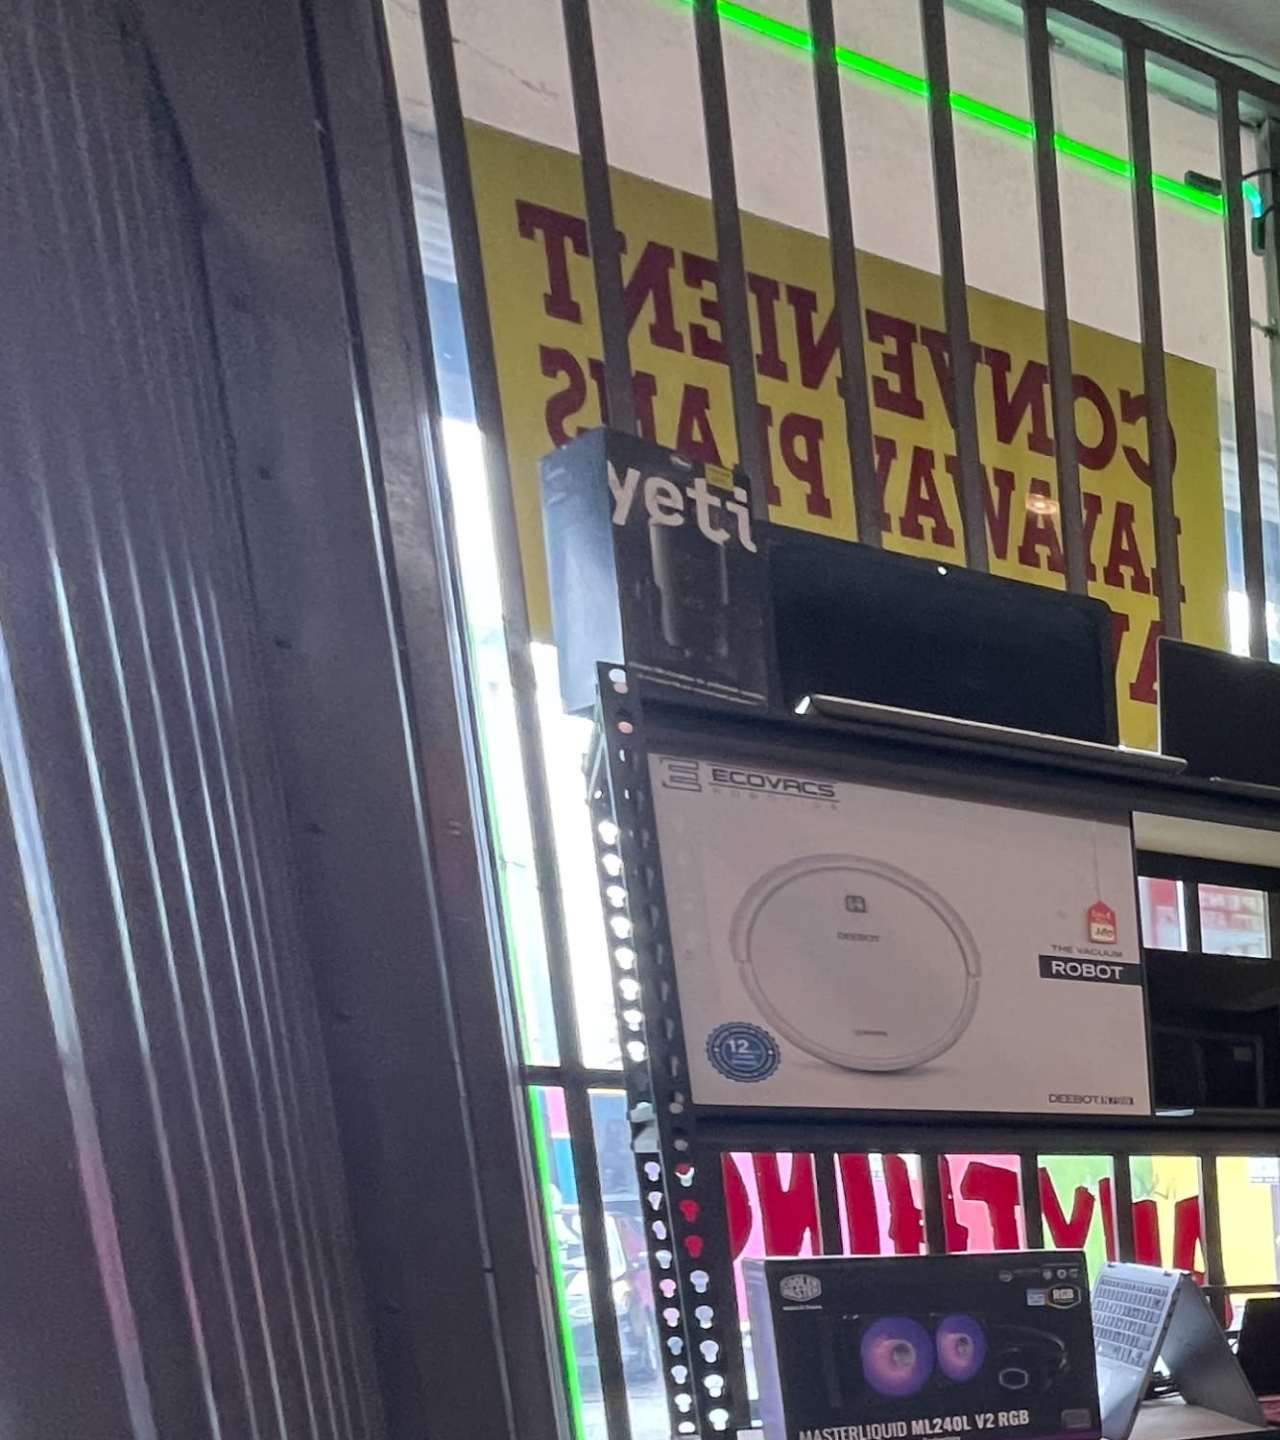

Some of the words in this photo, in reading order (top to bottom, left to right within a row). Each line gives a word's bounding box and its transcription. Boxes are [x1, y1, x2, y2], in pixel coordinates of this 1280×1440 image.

[606, 459, 758, 553] yeti
[711, 767, 836, 798] ECOVACS
[1051, 960, 1124, 980] ROBOT
[729, 1039, 750, 1053] 12
[911, 1415, 972, 1436] ML240L
[976, 1412, 995, 1430] V2
[998, 1409, 1030, 1428] RGB
